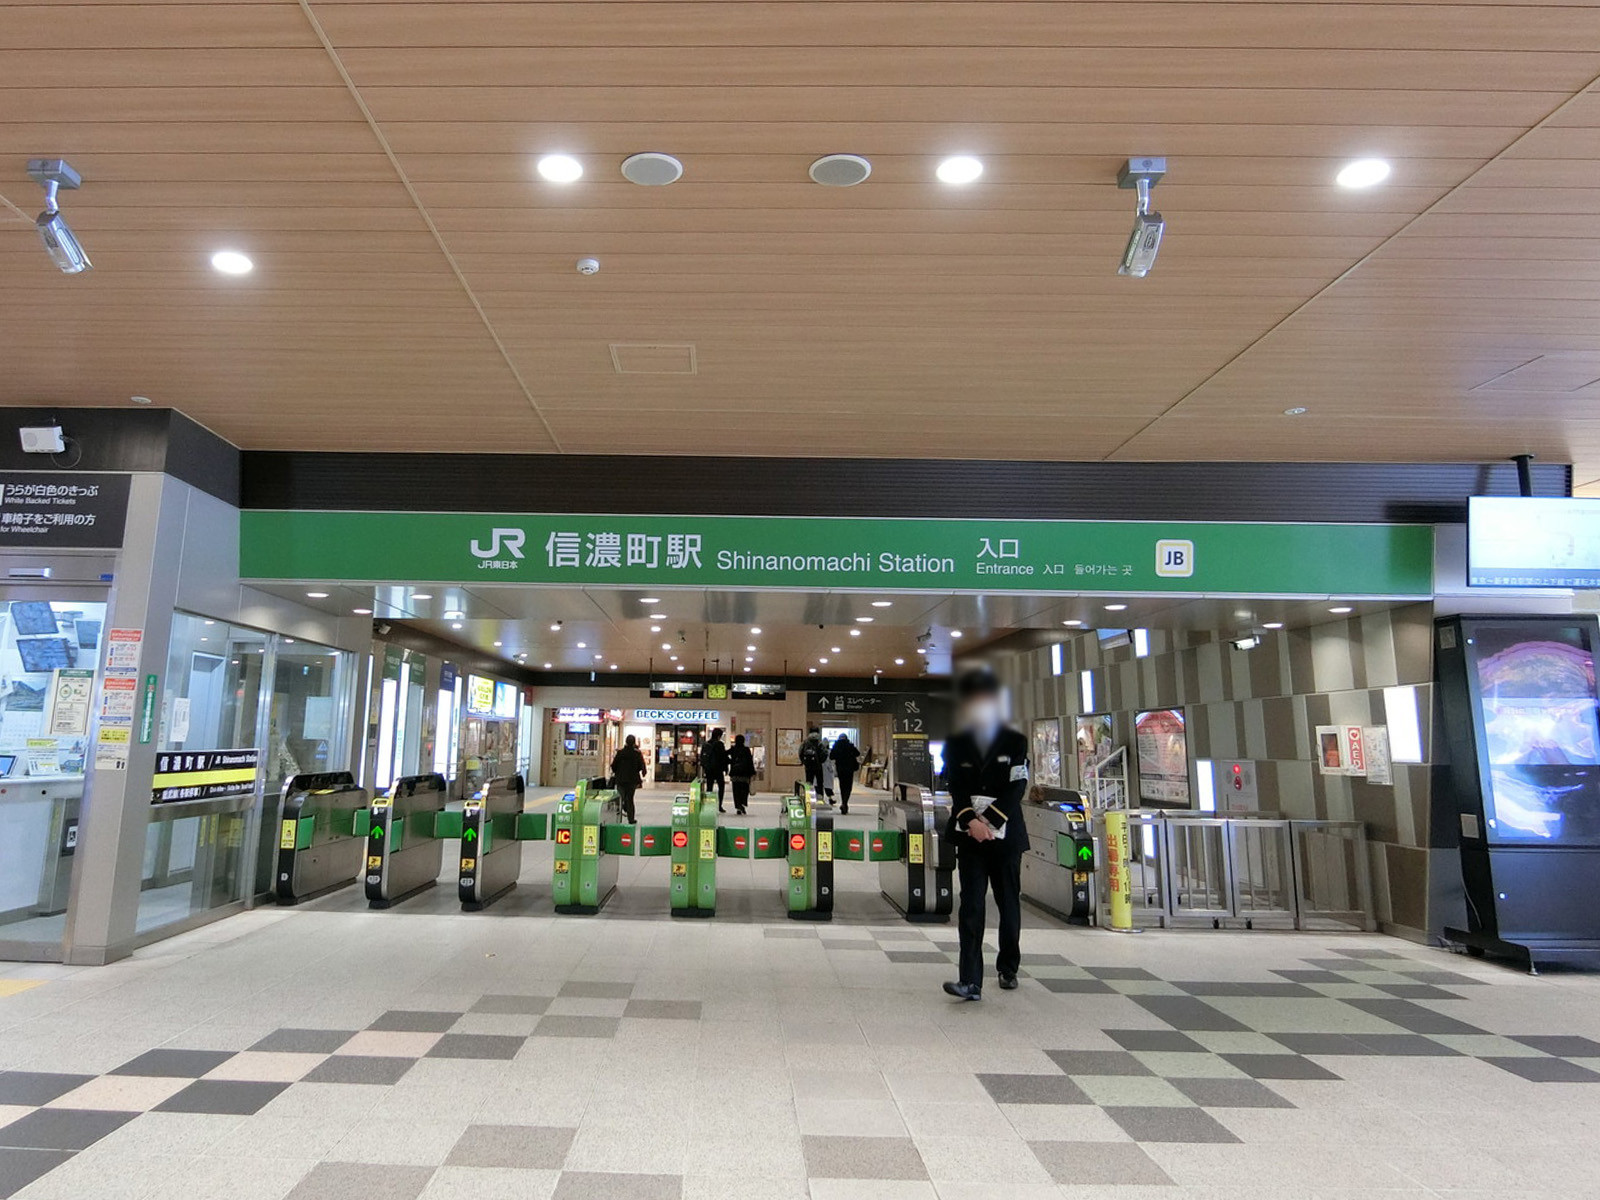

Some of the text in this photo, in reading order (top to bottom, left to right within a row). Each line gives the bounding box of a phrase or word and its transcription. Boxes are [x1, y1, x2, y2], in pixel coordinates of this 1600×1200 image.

[25, 497, 51, 505] Backed
[52, 497, 76, 506] Tickets
[2, 513, 97, 526] 車椅子をご利用の方
[11, 526, 49, 534] Wheelchair
[470, 528, 526, 559] JR
[545, 531, 703, 569] 信濃町駅
[976, 538, 1020, 560] 入口
[477, 560, 518, 570] JR東日本
[717, 550, 955, 573] Shinanomachi Station
[1164, 551, 1185, 566] JB
[976, 562, 1035, 575] Entrance
[1043, 563, 1065, 575] 入口
[1074, 563, 1134, 577] 들어가는 곳
[847, 697, 882, 705] エレベーター
[636, 710, 718, 720] BECK'S COFFEE
[558, 803, 573, 814] IC
[790, 808, 805, 819] IC
[558, 830, 571, 844] IC
